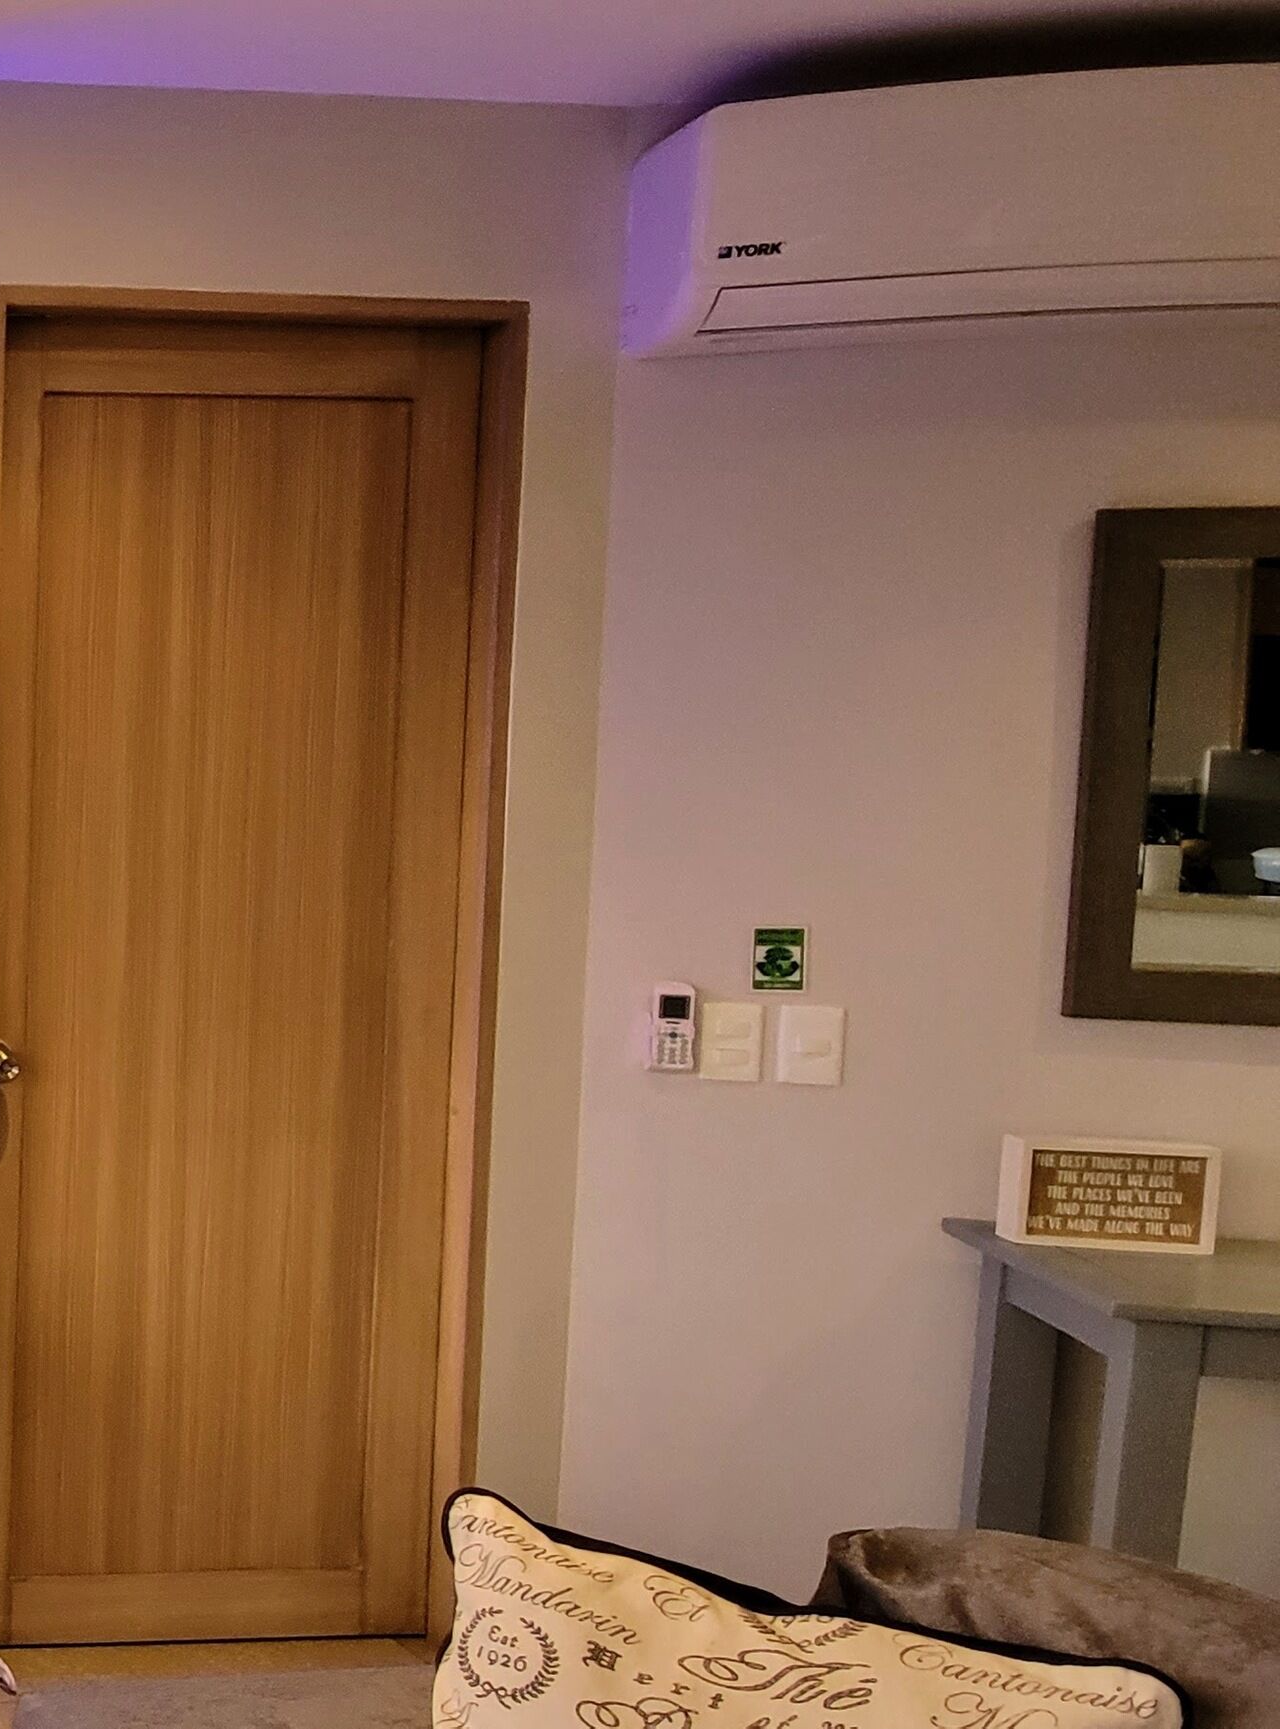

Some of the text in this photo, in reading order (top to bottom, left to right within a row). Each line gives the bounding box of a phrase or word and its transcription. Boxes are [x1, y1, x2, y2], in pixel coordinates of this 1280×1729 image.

[735, 241, 782, 257] YORK
[1060, 1154, 1088, 1168] BEST
[1056, 1170, 1078, 1184] THE
[1083, 1171, 1121, 1186] PEOPLE
[1047, 1185, 1068, 1199] THE
[1072, 1187, 1112, 1202] PLACES
[1154, 1191, 1183, 1205] BEEN
[1055, 1201, 1080, 1215] AND
[1085, 1203, 1106, 1217] THE
[1145, 1222, 1165, 1236] THE
[455, 1543, 641, 1645] Mandarin
[488, 1625, 520, 1649] Est
[476, 1645, 528, 1673] 1926
[899, 1643, 1159, 1719] Cantonaise
